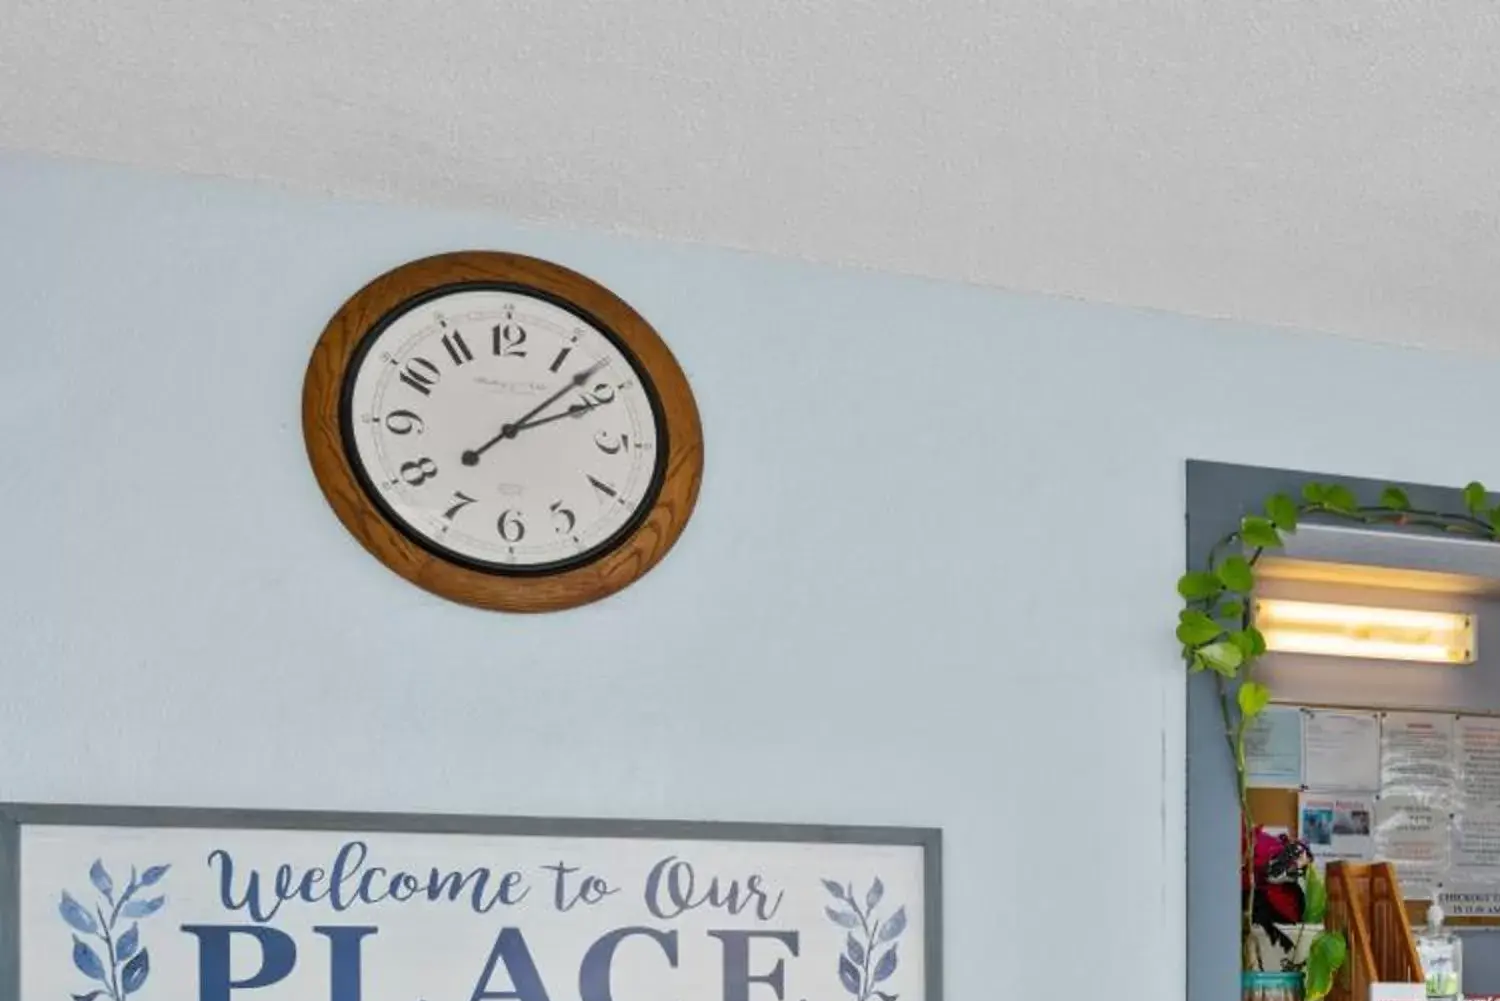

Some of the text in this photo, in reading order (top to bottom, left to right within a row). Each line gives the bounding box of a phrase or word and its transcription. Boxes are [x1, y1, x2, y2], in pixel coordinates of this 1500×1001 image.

[440, 328, 475, 367] 11
[491, 322, 528, 359] 12
[398, 355, 442, 397] 10
[549, 346, 574, 374] 1
[384, 408, 426, 436] 9
[593, 430, 630, 456] 3
[399, 456, 439, 487] 8
[442, 490, 480, 522] 7
[549, 500, 577, 536] 5
[495, 508, 526, 544] 6
[207, 840, 785, 924] Welcome to Our
